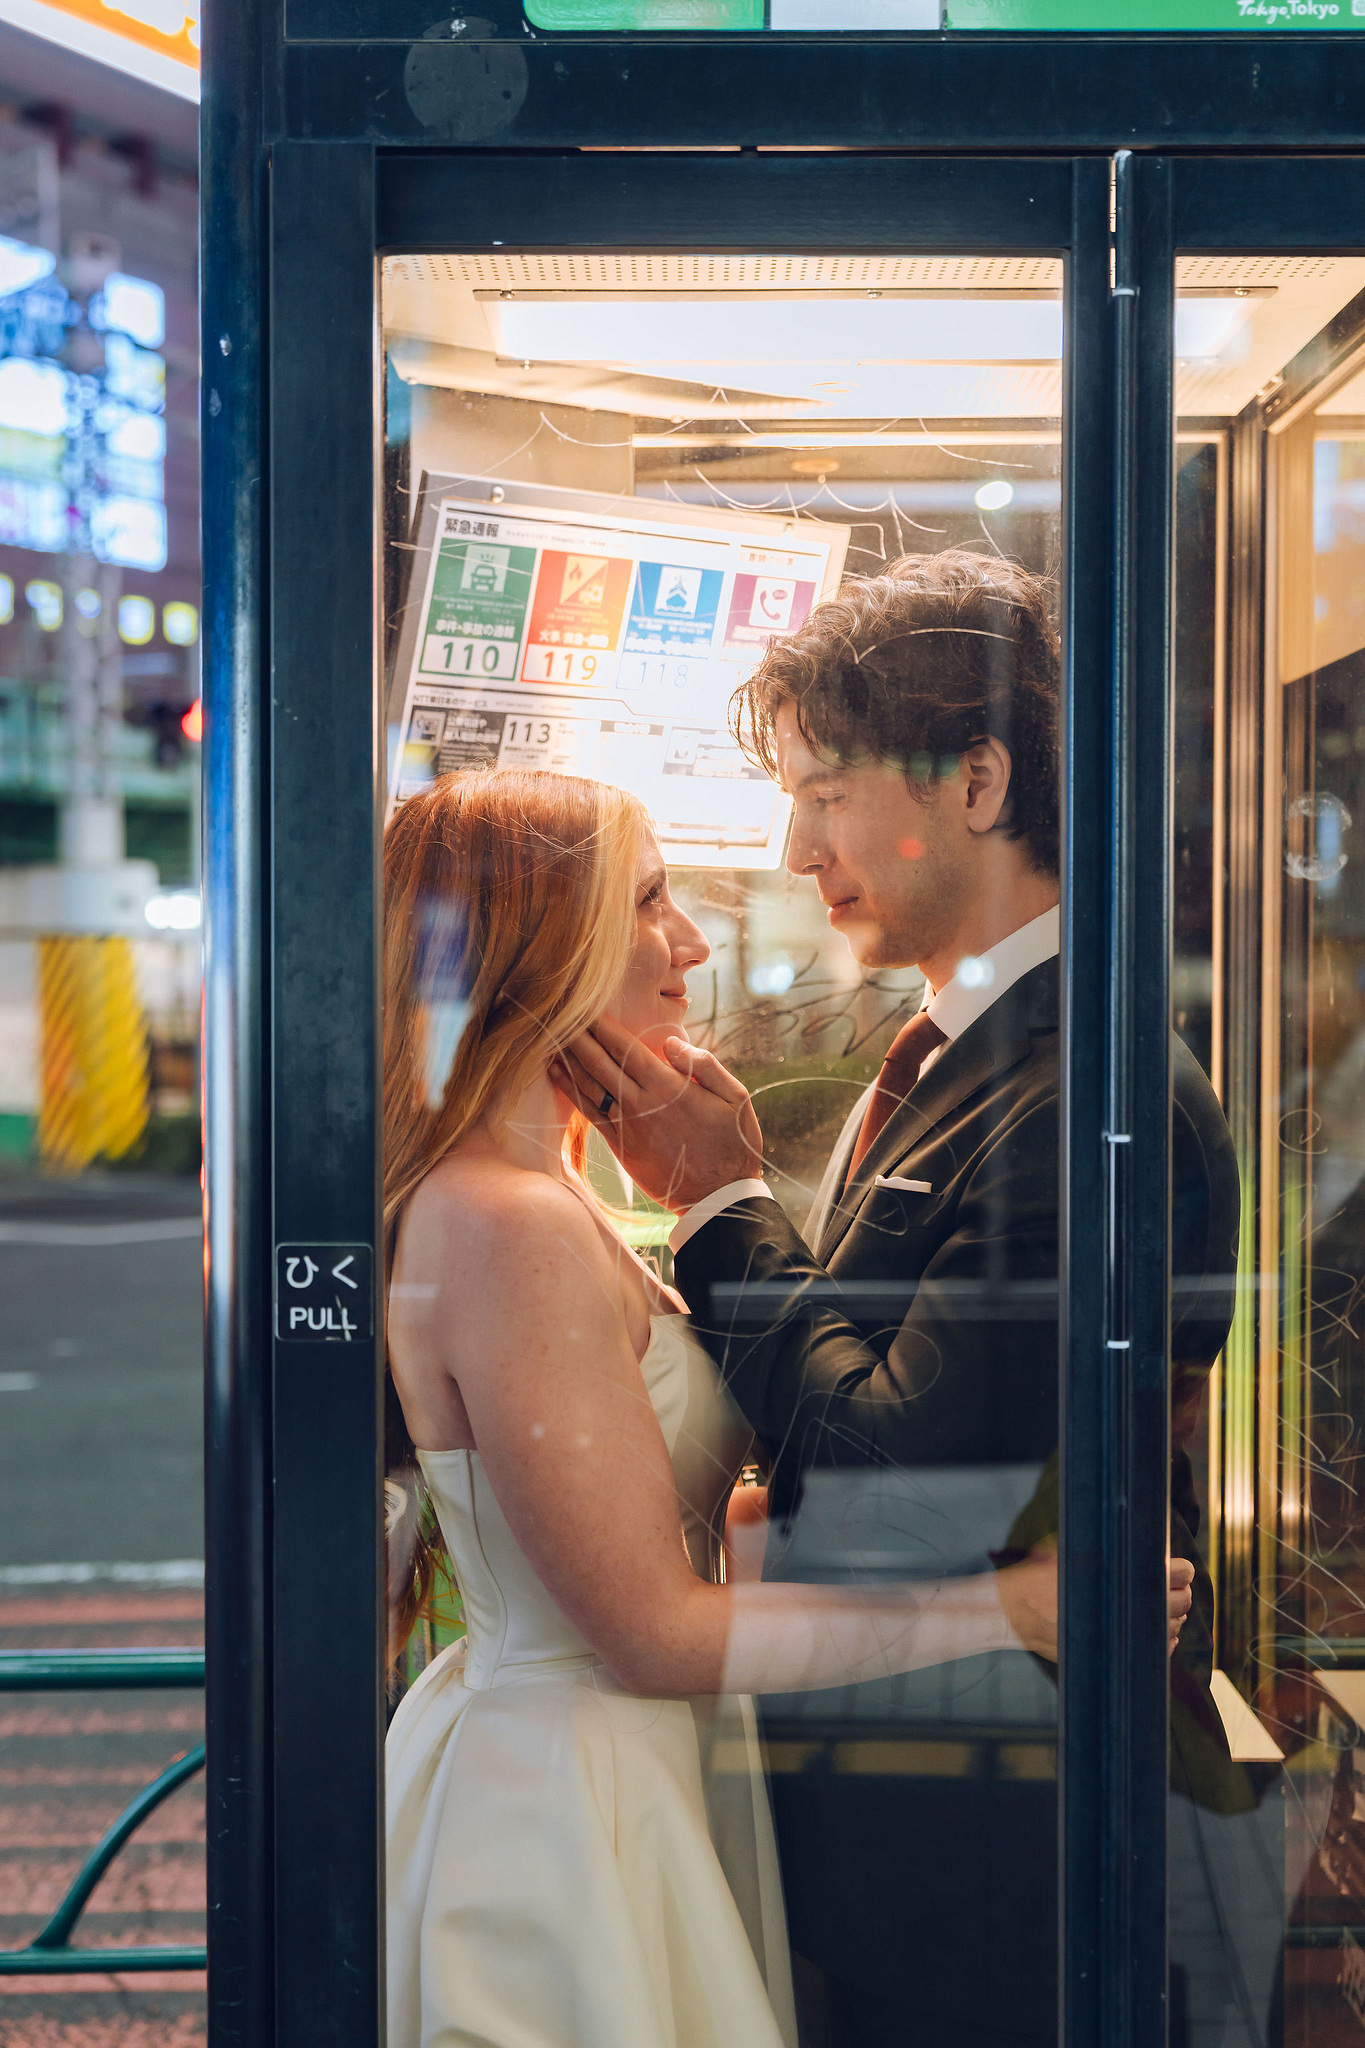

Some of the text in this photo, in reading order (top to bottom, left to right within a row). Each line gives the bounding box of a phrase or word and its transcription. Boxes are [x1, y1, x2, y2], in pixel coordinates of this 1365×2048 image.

[1287, 0, 1340, 19] Tokyo
[444, 518, 499, 537] 緊急通報
[443, 641, 500, 673] 110
[544, 651, 598, 681] 119
[640, 660, 689, 688] 118
[509, 720, 551, 744] 113
[285, 1255, 358, 1290] ひく
[289, 1306, 358, 1330] PULL
